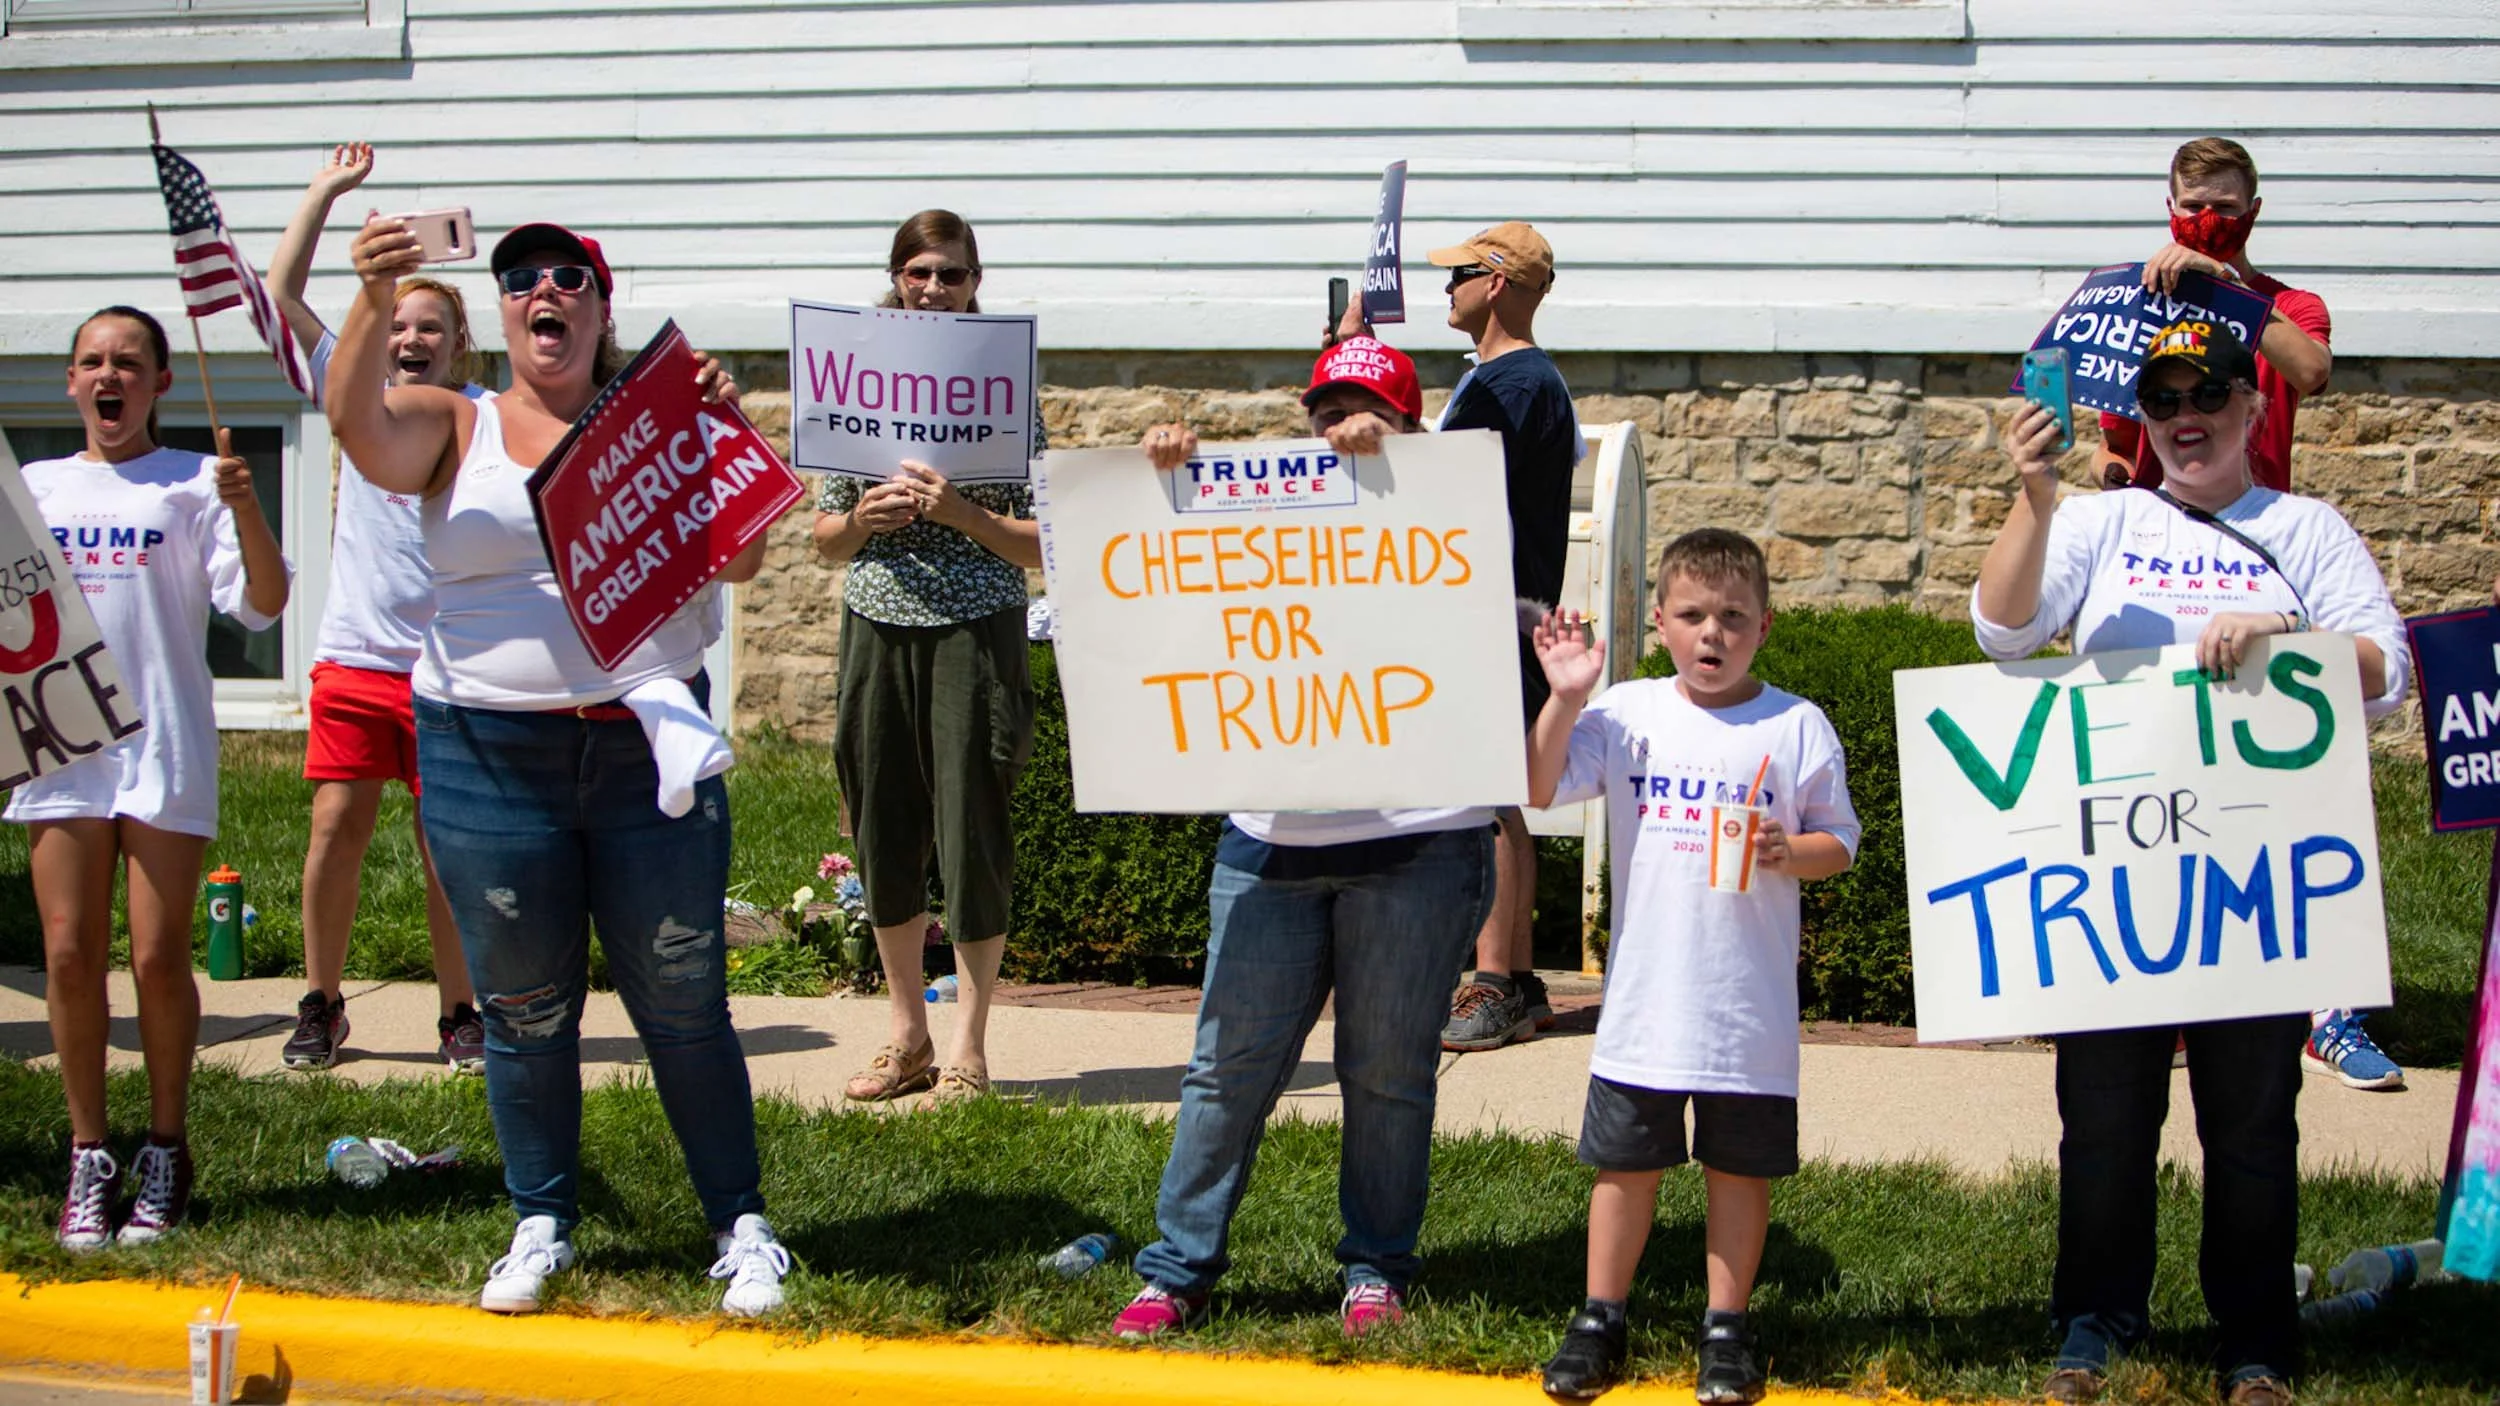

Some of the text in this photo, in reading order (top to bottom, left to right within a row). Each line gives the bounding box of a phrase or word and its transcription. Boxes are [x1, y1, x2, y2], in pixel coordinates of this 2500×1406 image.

[2070, 285, 2143, 306] AGAIN
[1340, 336, 1383, 352] KEEP
[2053, 312, 2162, 355] ERICA
[1323, 350, 1396, 373] AMERICA
[1329, 364, 1384, 381] GREAT
[2076, 353, 2140, 386] AKE
[806, 347, 1014, 417] Women
[828, 413, 993, 443] FOR TRUMP
[587, 409, 660, 495] MAKE
[1185, 455, 1339, 482] TRUMP
[386, 494, 409, 506] 2020
[568, 411, 740, 591] AMERICA
[1201, 479, 1326, 498] PENCE
[49, 527, 165, 549] RUMP
[583, 529, 673, 626] GREAT
[671, 446, 770, 544] AGAIN
[62, 551, 149, 566] ENCE
[1100, 525, 1473, 600] CHEESEHEADS
[2122, 552, 2270, 577] TRUMP
[0, 549, 56, 613] 854
[2128, 576, 2262, 592] PENCE
[2176, 605, 2209, 616] 2020
[1222, 603, 1323, 662] FOR
[1142, 665, 1435, 753] TRUMP
[1925, 650, 2335, 812] VETS
[1637, 804, 1702, 821] PEN
[2080, 789, 2211, 856] FOR
[1673, 841, 1705, 853] 2020
[1927, 835, 2365, 998] TRUMP
